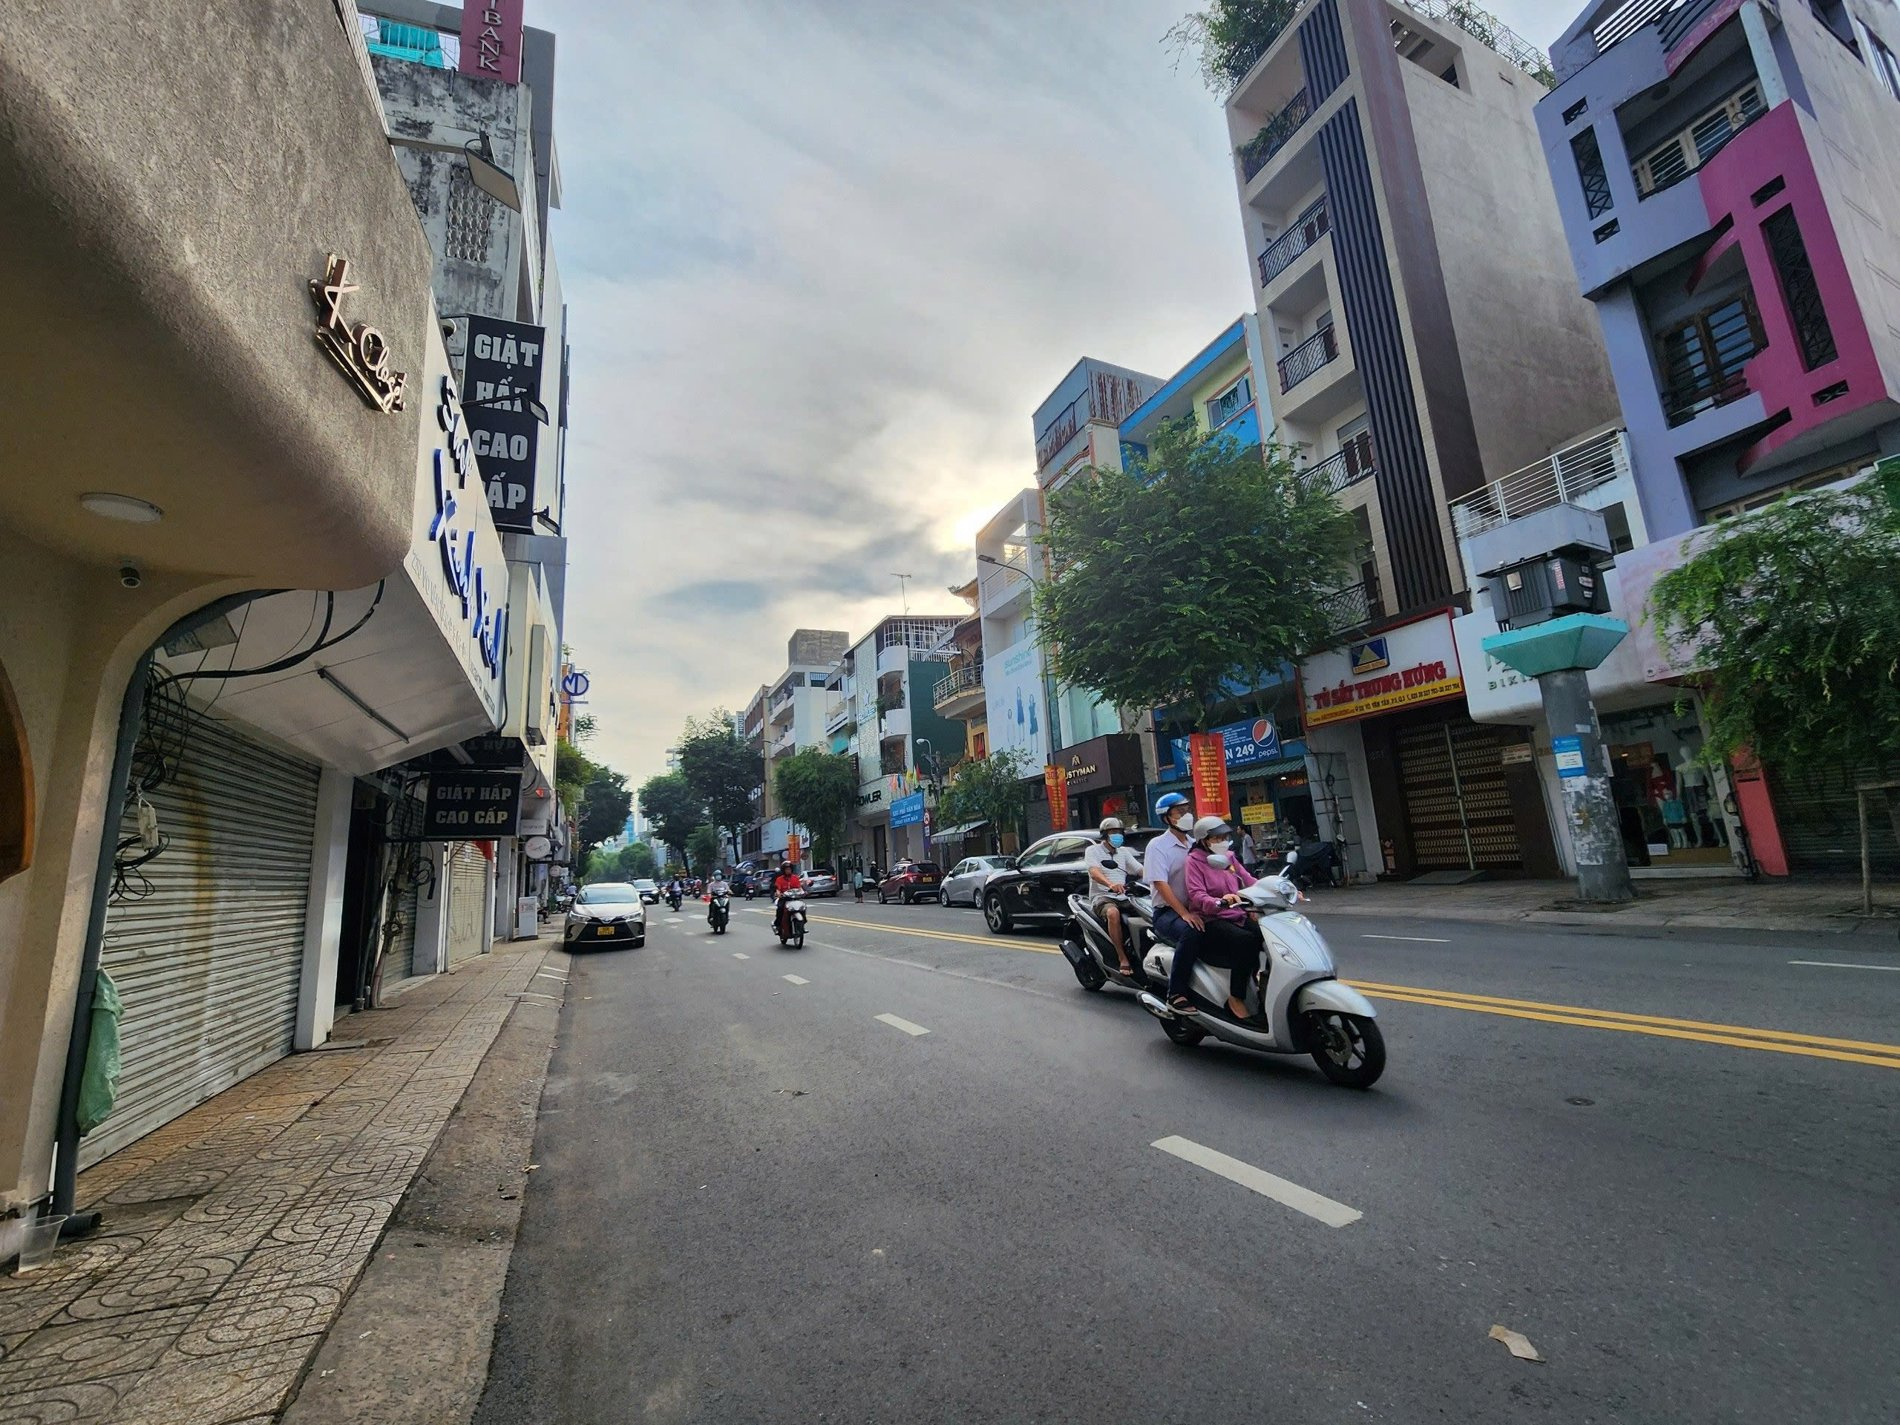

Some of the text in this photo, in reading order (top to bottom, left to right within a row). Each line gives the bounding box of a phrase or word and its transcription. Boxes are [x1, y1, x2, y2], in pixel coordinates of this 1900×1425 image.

[474, 333, 539, 369] GIẶT
[471, 429, 528, 461] CAO
[482, 471, 527, 510] ẤP
[1235, 743, 1255, 758] 249
[436, 782, 512, 802] GIẶT HẤP
[435, 806, 508, 824] CAO CẤP
